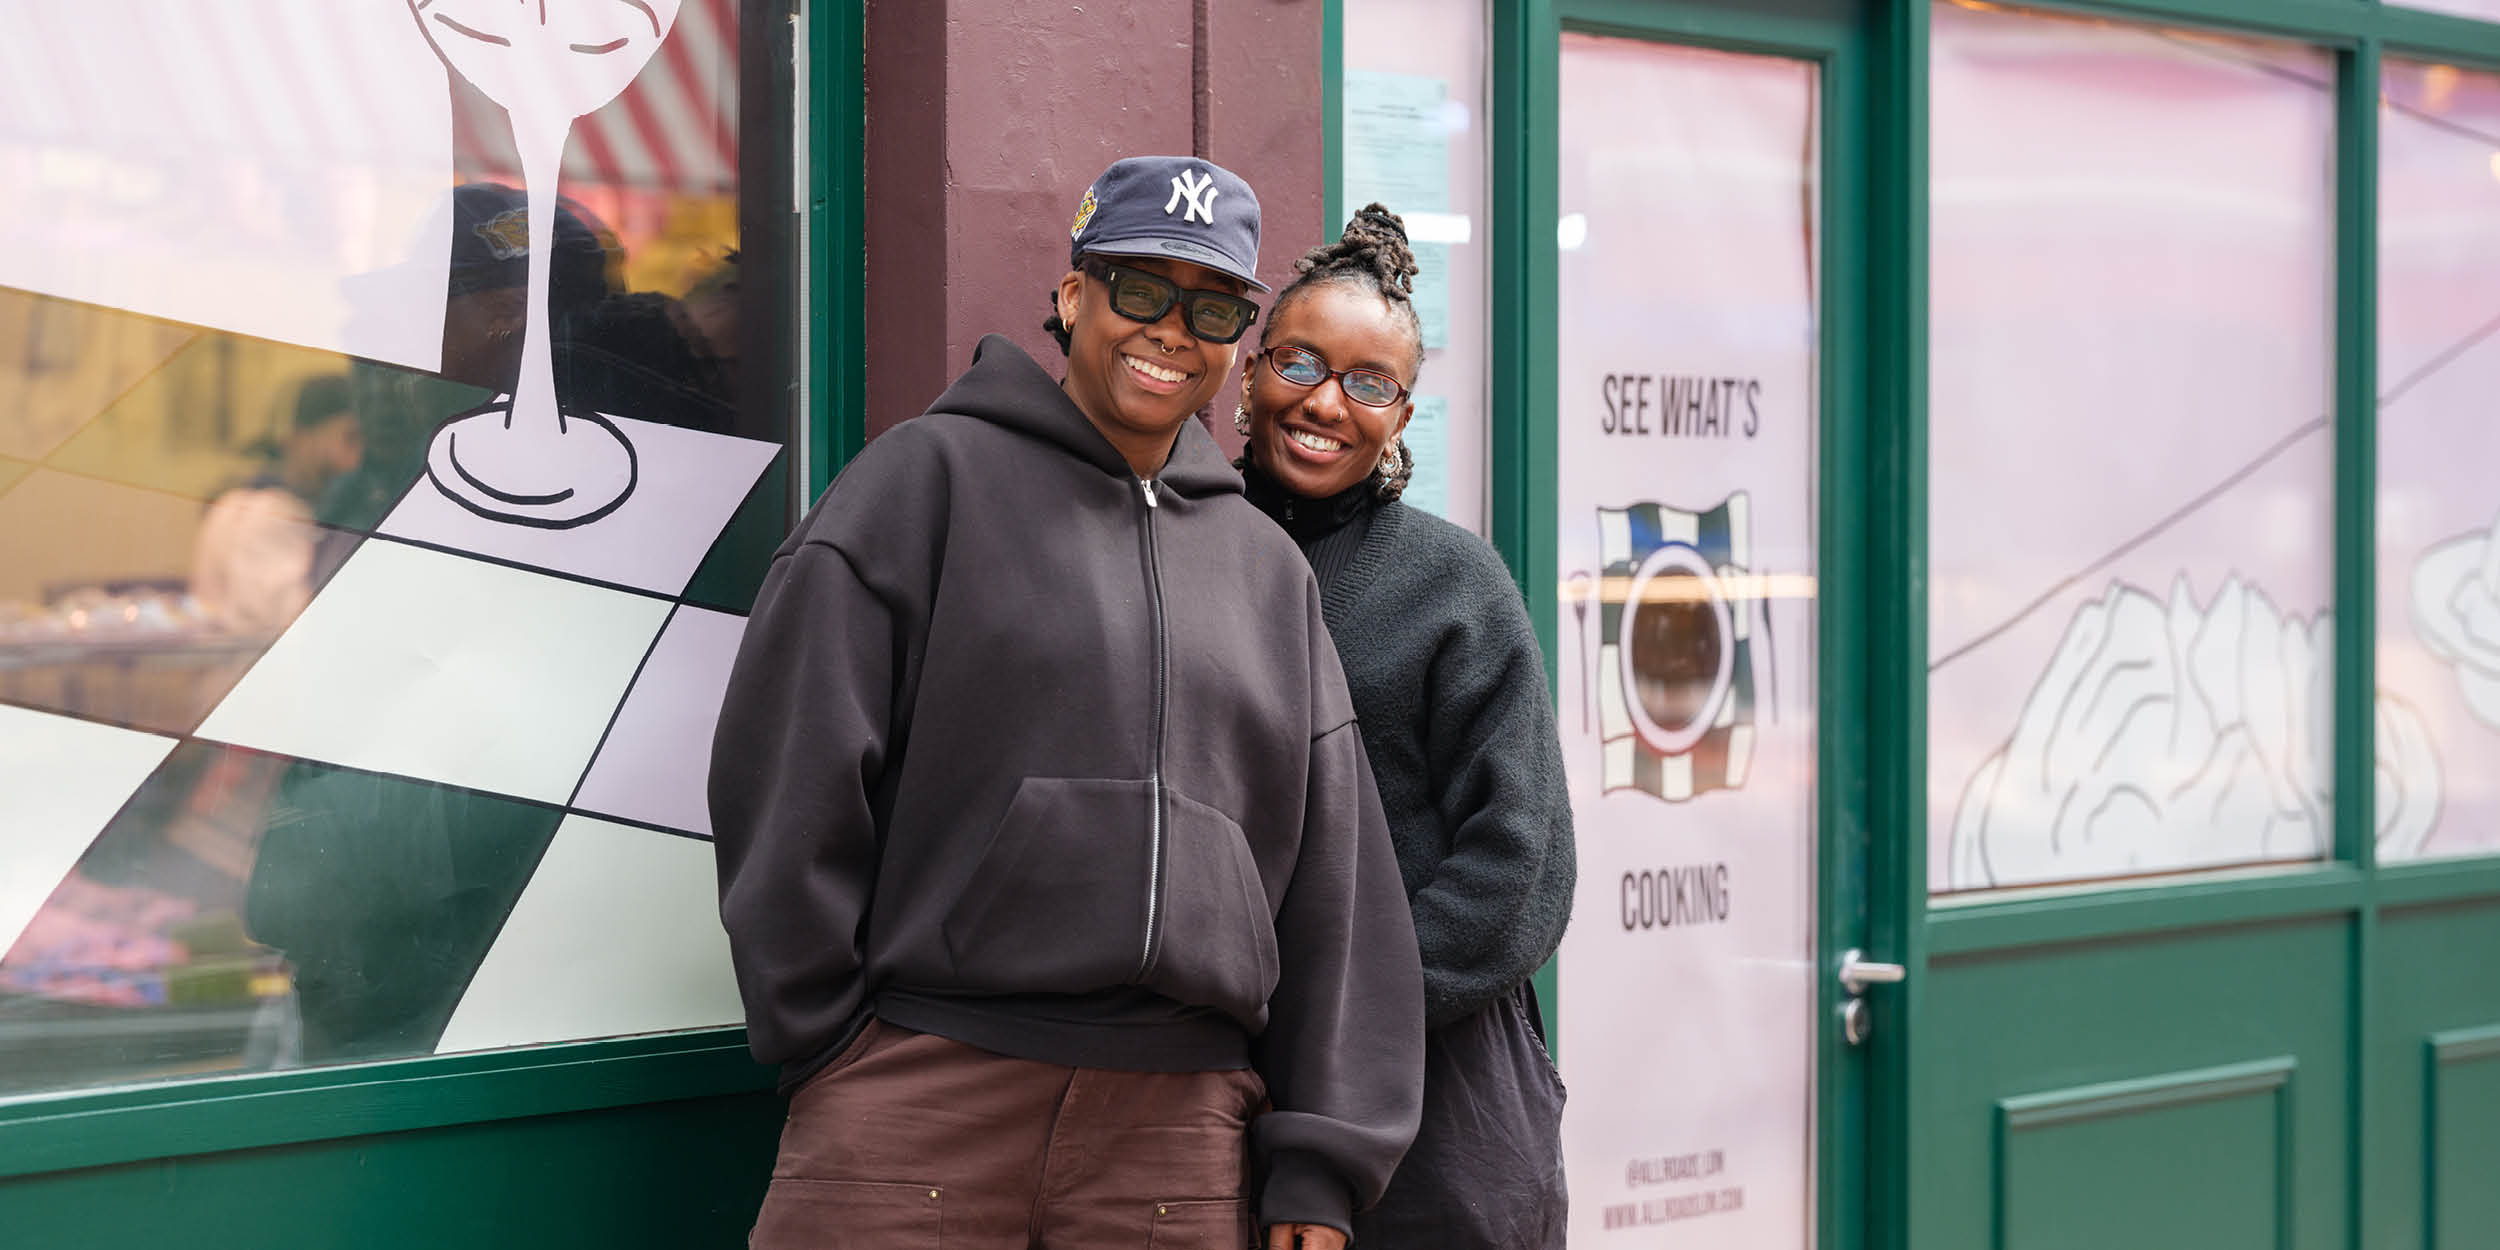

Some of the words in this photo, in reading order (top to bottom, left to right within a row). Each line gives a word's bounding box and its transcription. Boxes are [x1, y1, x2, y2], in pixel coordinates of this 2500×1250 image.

[1164, 168, 1219, 226] NY
[1602, 374, 1651, 436] SEE
[1660, 376, 1761, 438] WHAT'S
[1621, 863, 1729, 931] COOKING
